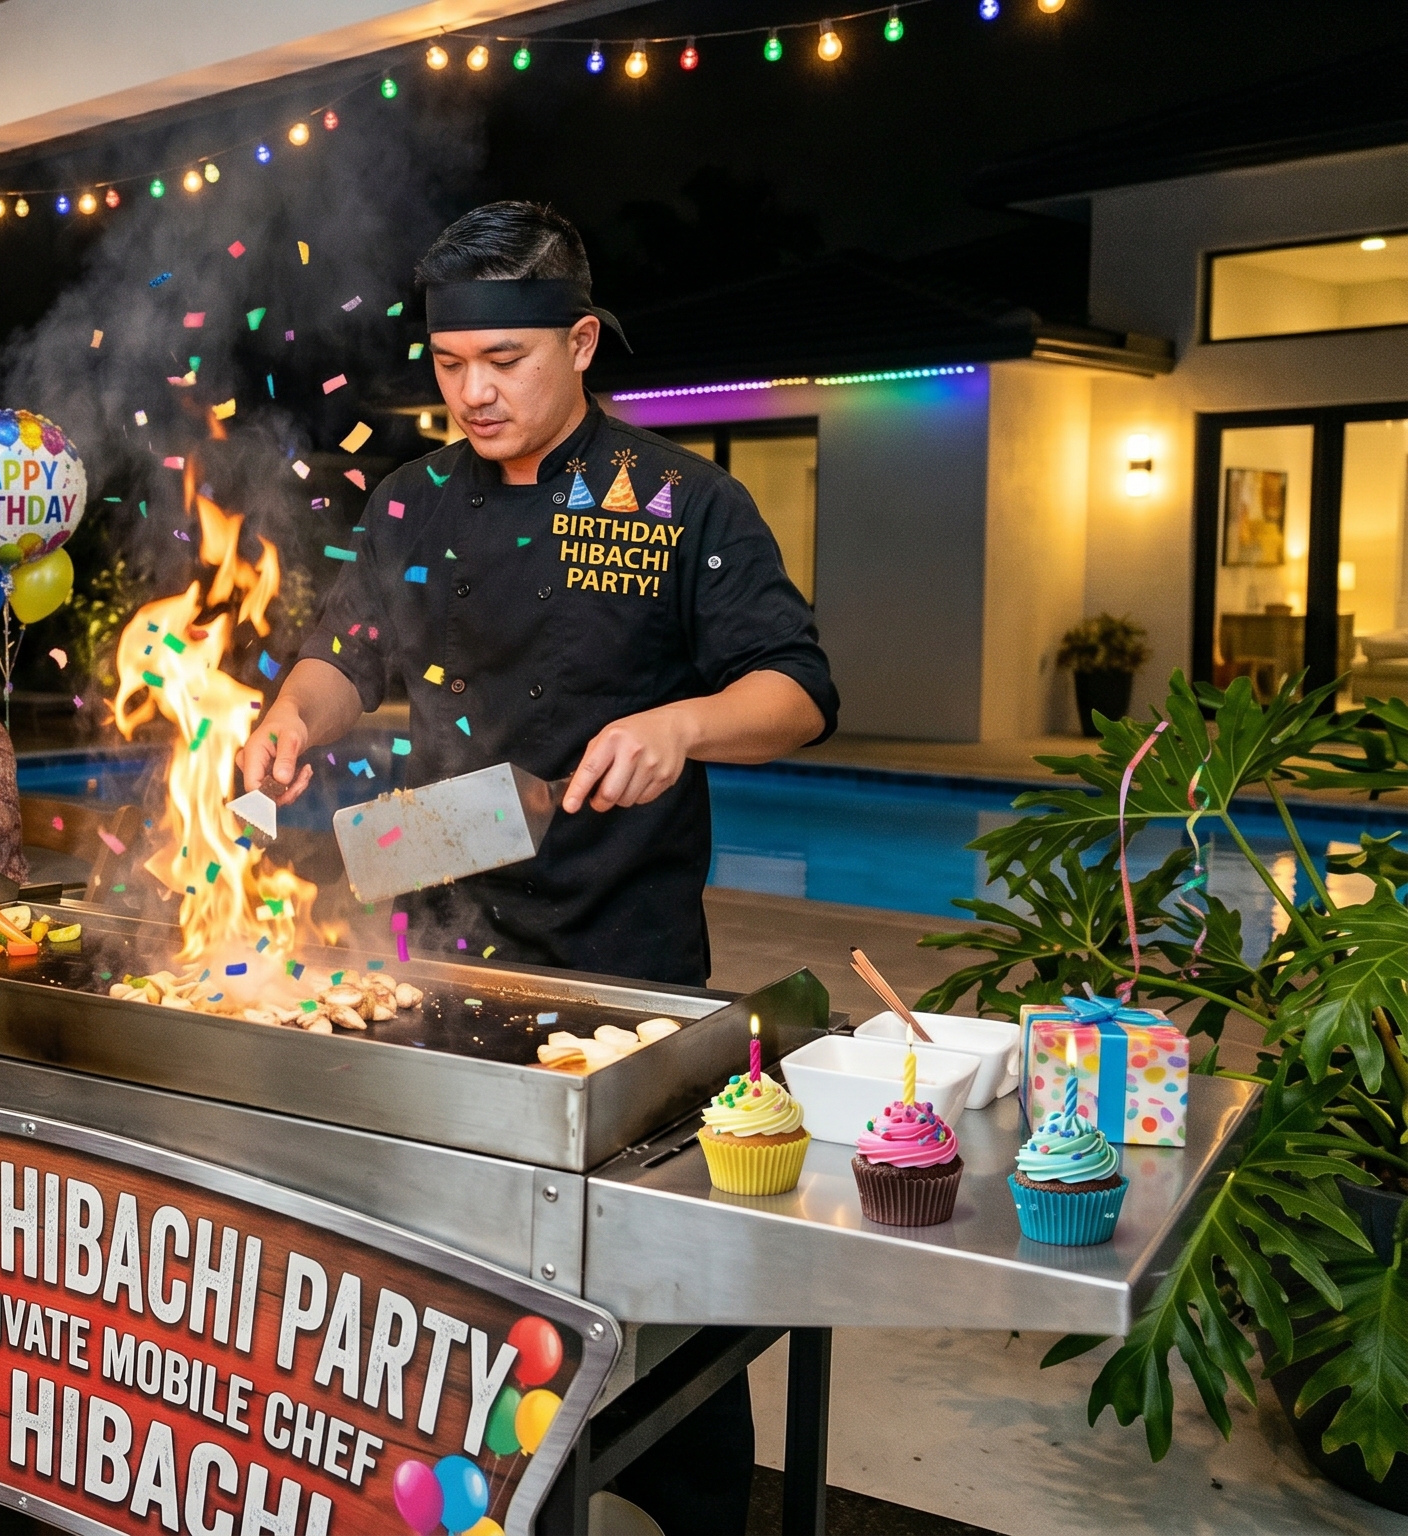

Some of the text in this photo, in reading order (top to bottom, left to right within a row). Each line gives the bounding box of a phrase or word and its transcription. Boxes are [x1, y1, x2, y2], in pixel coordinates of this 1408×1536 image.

[552, 513, 685, 547] BIRTHDAY
[560, 540, 669, 572] HIBACHI
[566, 567, 660, 598] PARTY!
[0, 1160, 262, 1354] HIBACHI
[276, 1251, 519, 1457] PARTY
[102, 1326, 254, 1435] MOBILE
[263, 1391, 384, 1487] CHEF
